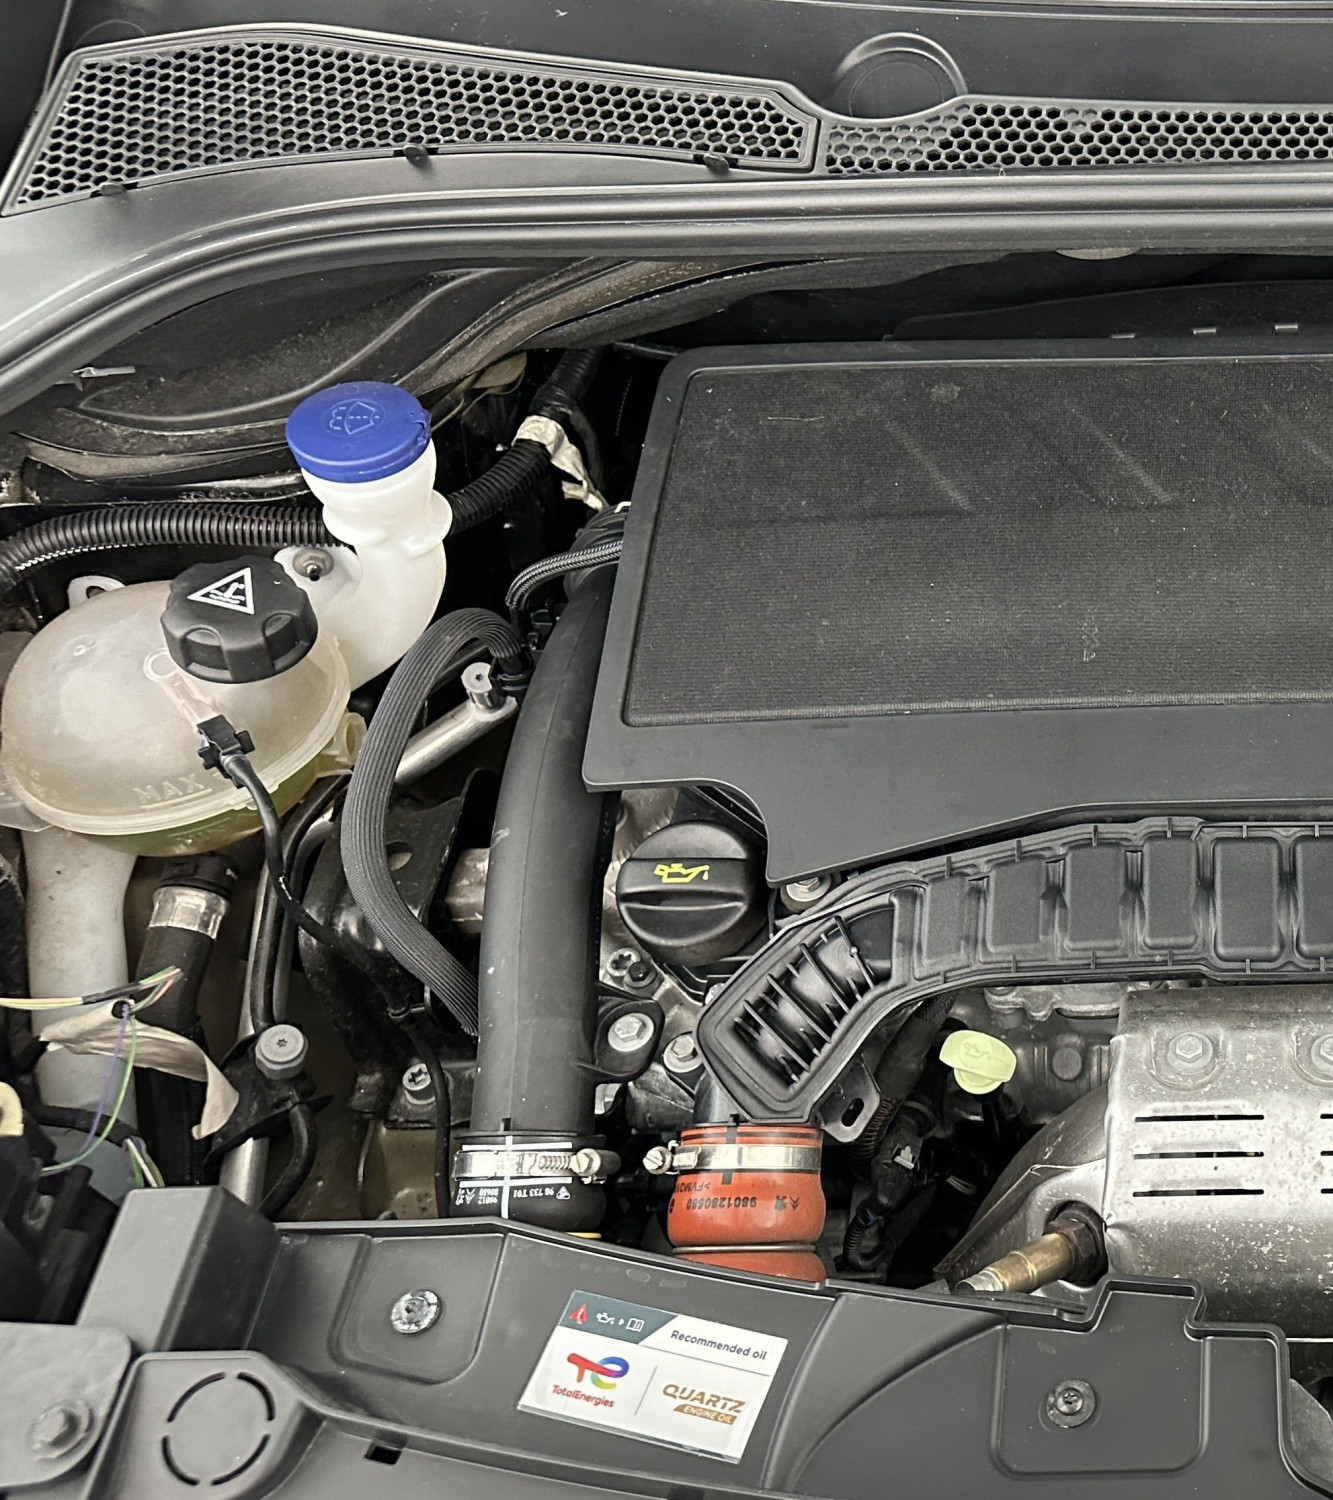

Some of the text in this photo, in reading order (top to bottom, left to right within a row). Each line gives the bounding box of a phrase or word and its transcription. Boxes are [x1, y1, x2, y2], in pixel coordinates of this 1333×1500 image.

[133, 773, 206, 803] MAX
[529, 1188, 543, 1197] 733
[670, 1330, 768, 1361] Recommended oil
[552, 1385, 615, 1408] TotalEnergies
[662, 1383, 746, 1414] QUARTZ
[683, 1405, 734, 1425] ENGINE OIL
